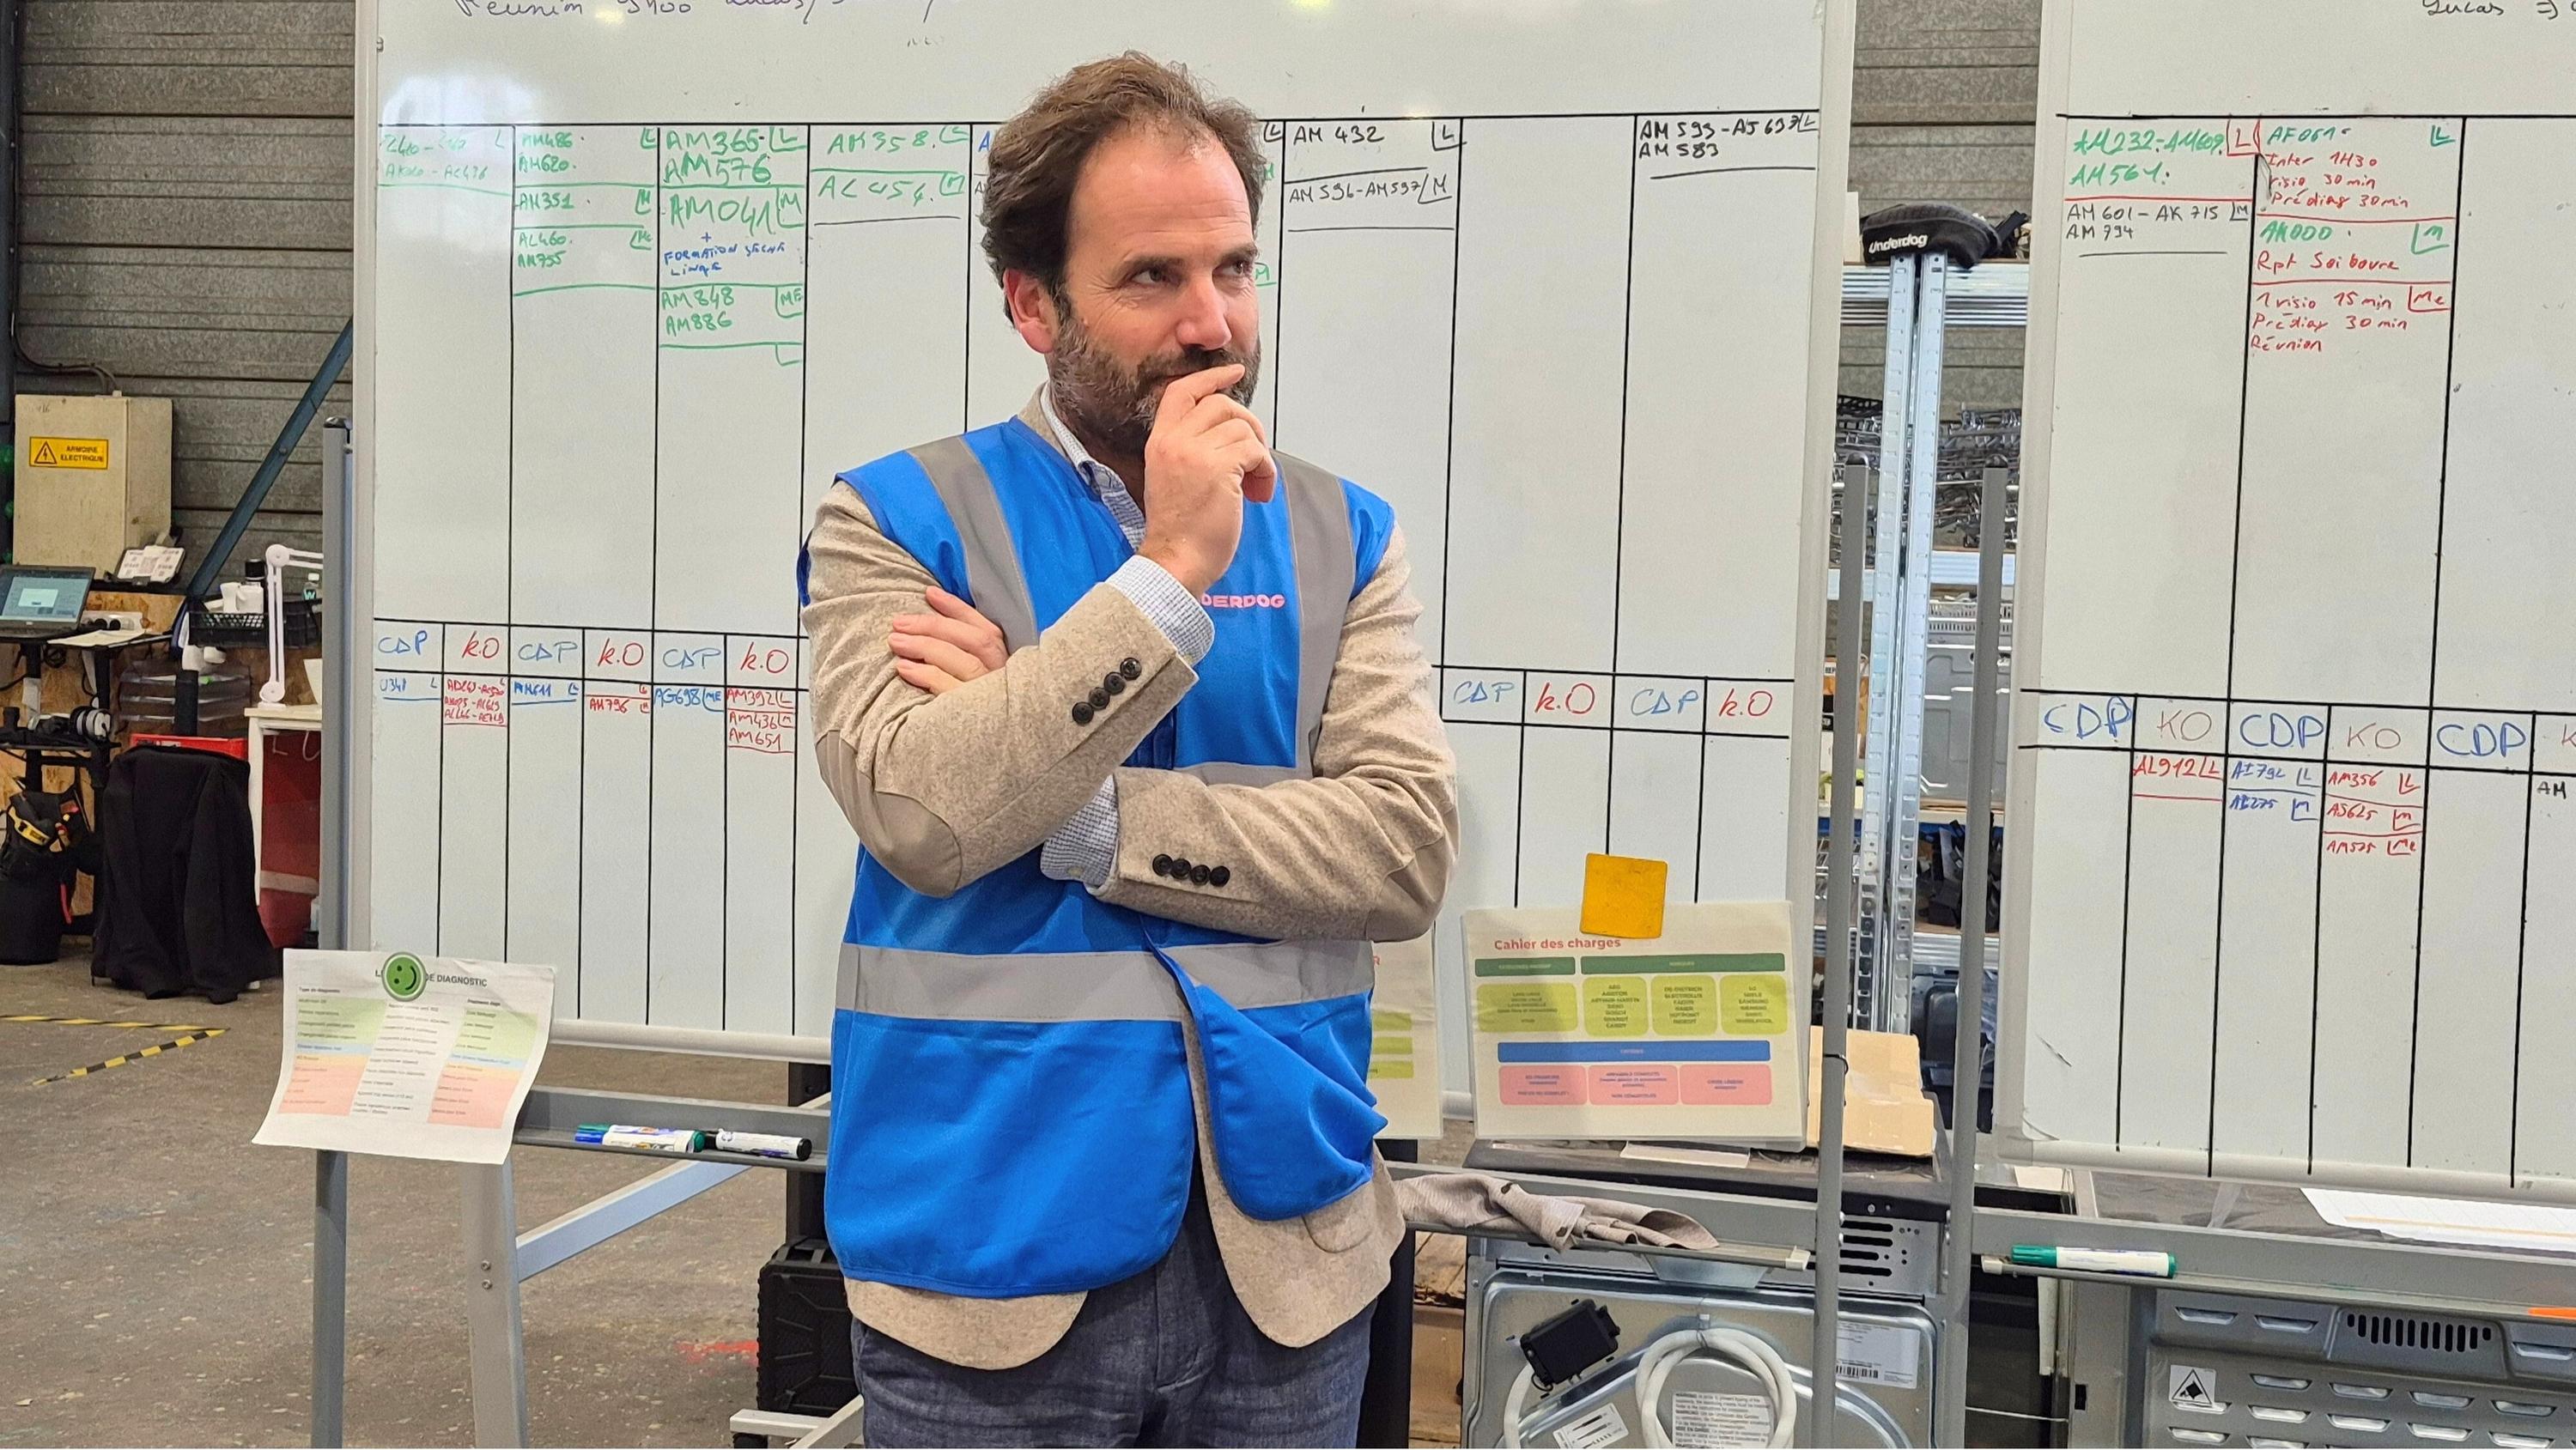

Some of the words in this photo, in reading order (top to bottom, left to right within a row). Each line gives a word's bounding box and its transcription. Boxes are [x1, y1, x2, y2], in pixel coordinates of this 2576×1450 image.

[1293, 125, 1323, 145] AM
[1334, 124, 1386, 144] 432
[2066, 203, 2095, 222] AM
[2065, 224, 2095, 240] AM
[1868, 233, 1929, 254] Underdog
[1201, 594, 1285, 608] DERDOG
[1494, 938, 1537, 950] Cahier
[1540, 938, 1564, 949] des
[1568, 937, 1622, 950] charges
[436, 974, 489, 988] DIAGNOSTIC
